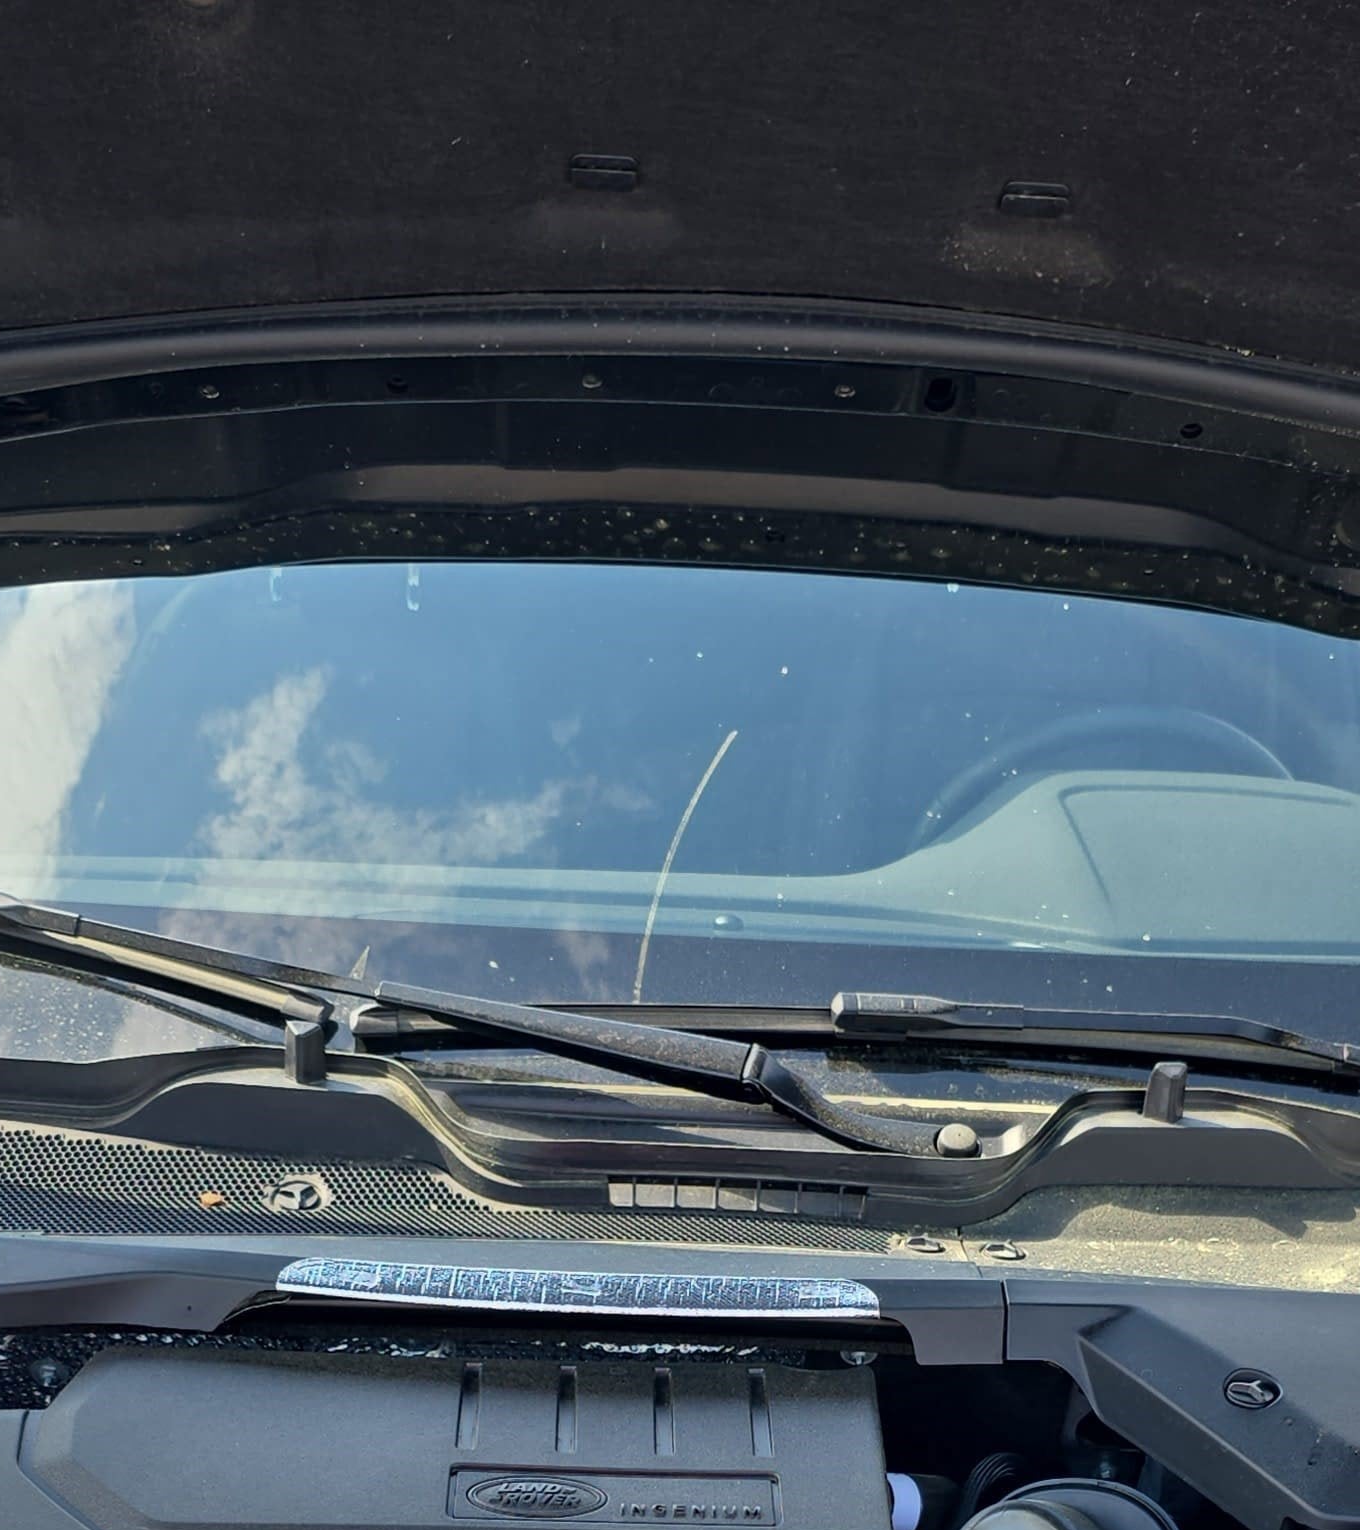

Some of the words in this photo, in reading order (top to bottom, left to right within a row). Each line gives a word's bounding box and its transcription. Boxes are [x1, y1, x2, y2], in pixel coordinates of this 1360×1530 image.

[498, 1483, 562, 1494] LAND
[501, 1493, 582, 1507] ROVER
[620, 1502, 763, 1520] INGENIUM
